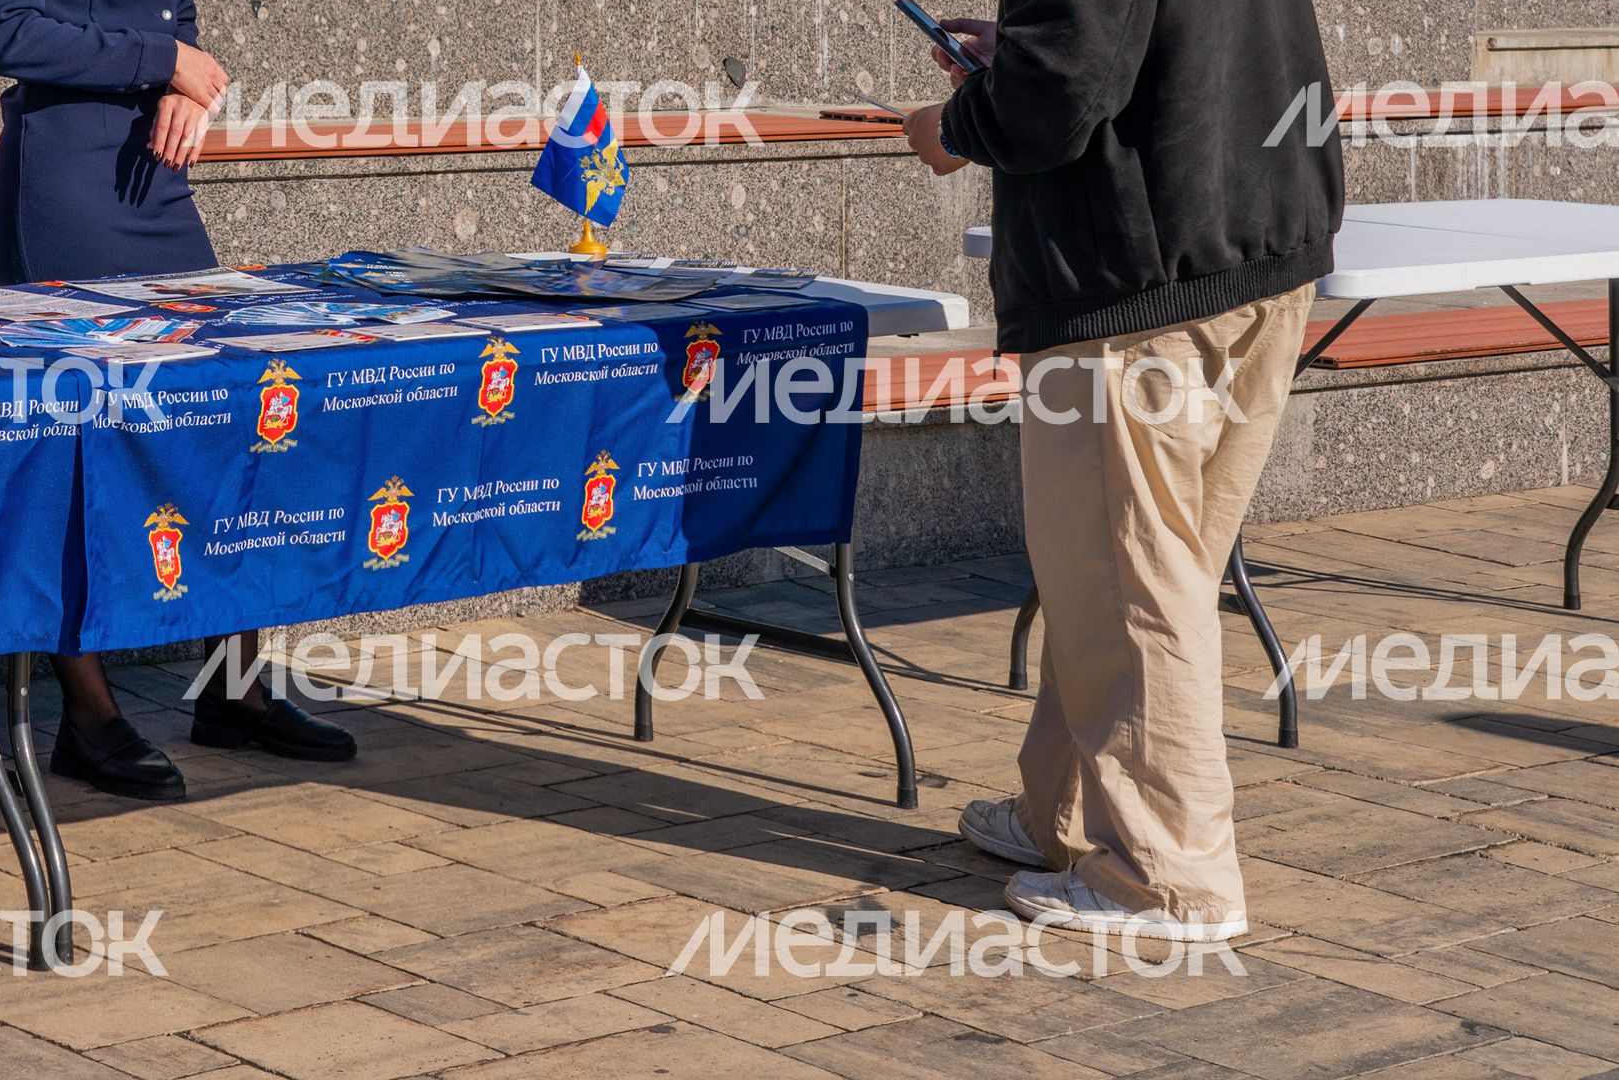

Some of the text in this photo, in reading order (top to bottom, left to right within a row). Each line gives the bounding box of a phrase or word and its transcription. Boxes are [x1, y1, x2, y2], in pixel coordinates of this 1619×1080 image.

[743, 320, 854, 344] ГУ МВД России по
[541, 342, 658, 363] ГУ МВД России по
[736, 341, 855, 365] Московской области
[327, 362, 455, 387] ГУ МВД России по
[534, 363, 658, 385] Московской области
[29, 399, 79, 415] России
[158, 390, 208, 405] России
[212, 388, 228, 400] по
[322, 386, 458, 412] Московской области
[175, 411, 231, 427] области
[637, 455, 754, 477] ГУ МВД России по
[437, 479, 559, 503] ГУ МВД России по
[633, 476, 757, 500] Московской области
[213, 507, 345, 534] ГУ МВД России по
[432, 500, 561, 527] Московской области
[204, 530, 346, 556] Московской области
